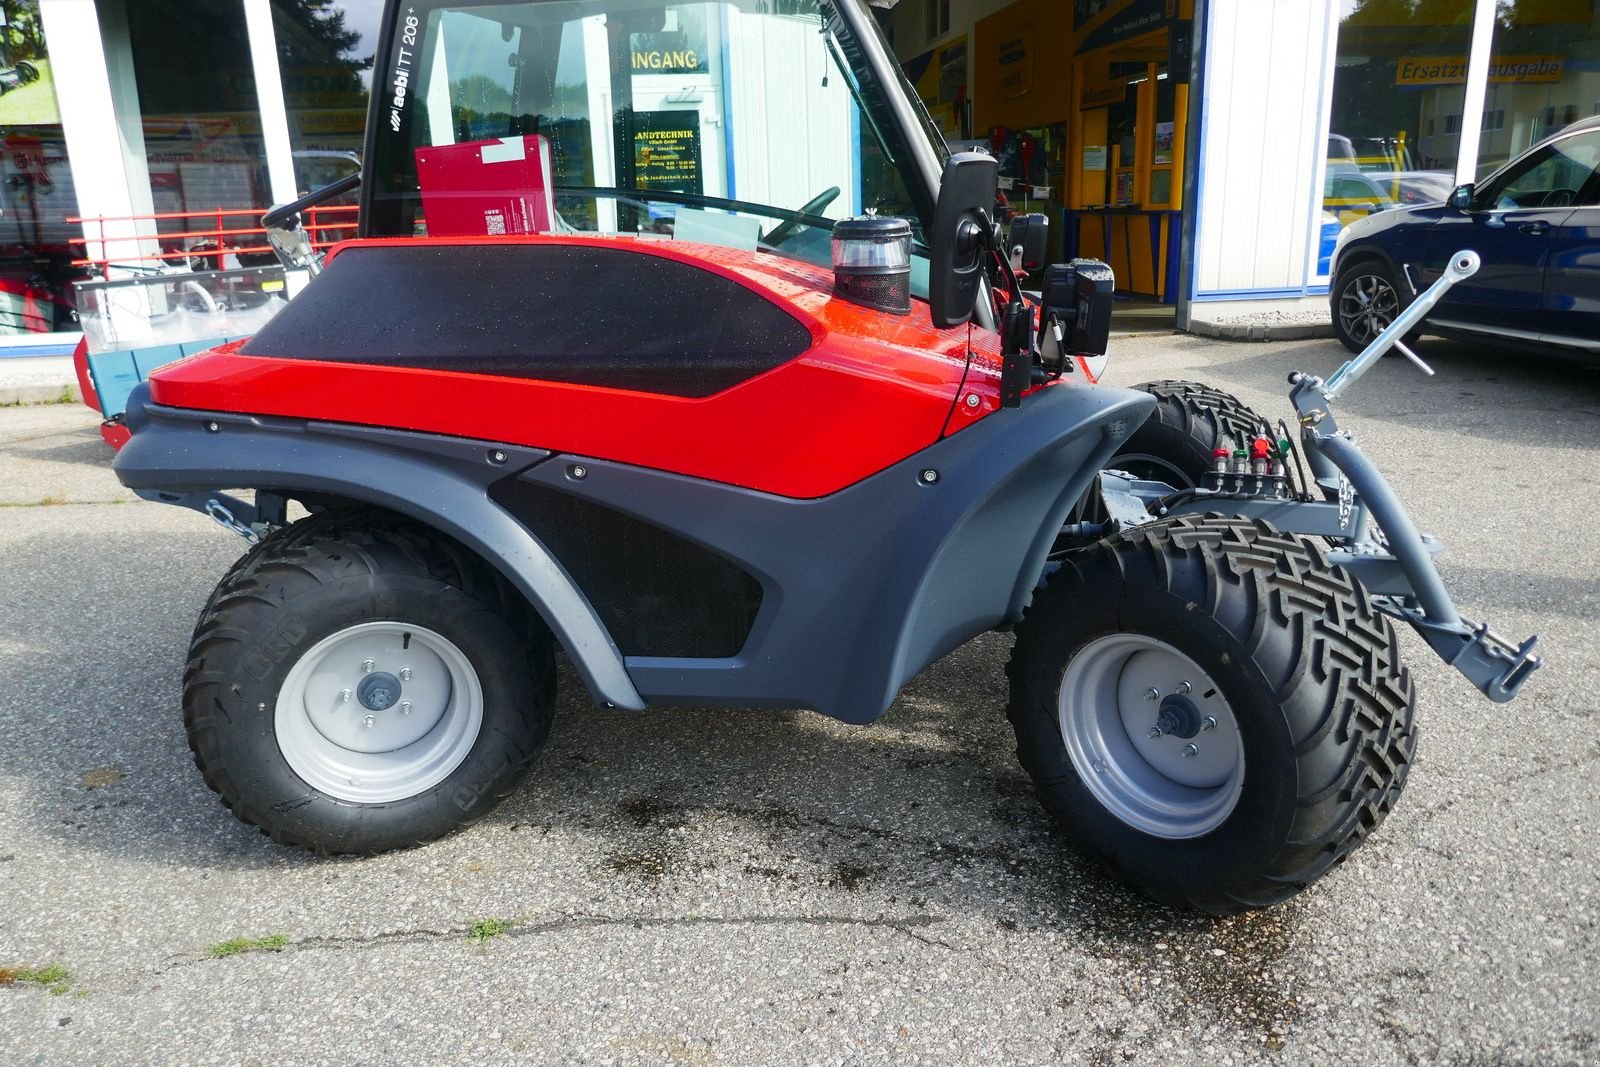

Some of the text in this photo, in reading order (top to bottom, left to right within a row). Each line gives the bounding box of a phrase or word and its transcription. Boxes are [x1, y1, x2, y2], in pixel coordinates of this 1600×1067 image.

[398, 46, 413, 66] TT
[632, 50, 697, 69] INGANG
[1402, 57, 1560, 80] Ersatztausgabe
[394, 69, 409, 108] aebi
